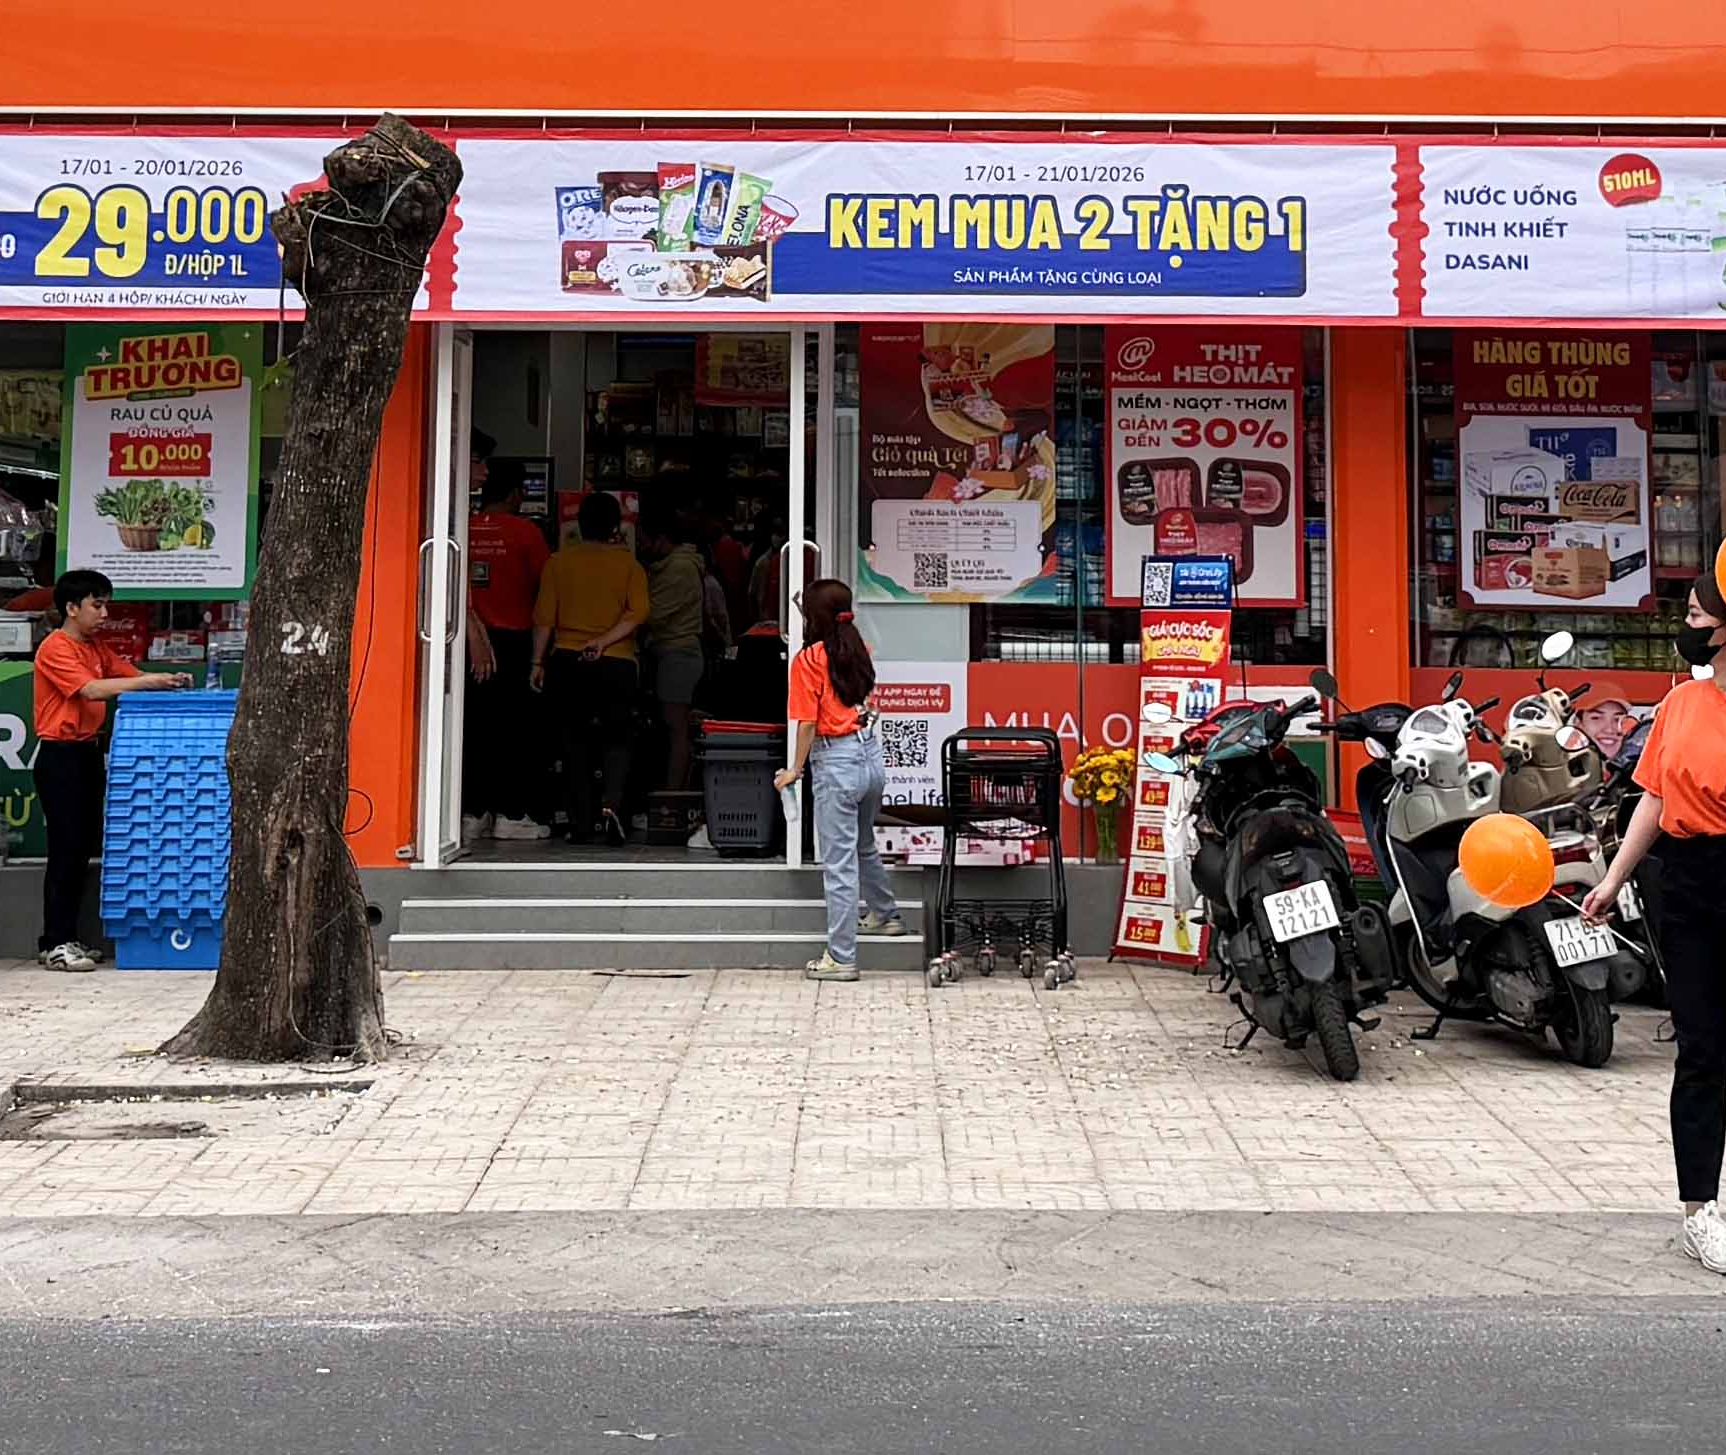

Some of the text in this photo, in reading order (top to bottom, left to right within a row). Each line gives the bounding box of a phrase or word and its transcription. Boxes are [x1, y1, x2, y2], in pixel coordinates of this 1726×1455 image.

[59, 160, 244, 178] 17/01 20/01/2026
[964, 164, 1145, 184] 17/01 21/01/2026
[1602, 168, 1656, 192] 510ML
[1443, 183, 1578, 208] NƯỚC UỐNG
[35, 184, 268, 278] 29.000
[829, 184, 1303, 269] KEM MUA 2 TẶNG 1
[1444, 214, 1569, 240] TINH KHIẾT
[165, 252, 248, 282] Đ/HỘP 1L
[1444, 253, 1530, 272] DASANI
[953, 266, 1163, 290] SẢN PHẨM TẶNG CÙNG LOẠI
[118, 334, 209, 363] KHAI
[1201, 344, 1262, 364] THỊT
[1474, 337, 1631, 366] HÀNG THÙNG
[86, 356, 240, 392] TRƯƠNG
[1173, 362, 1294, 385] HEO MÁT
[1505, 367, 1599, 399] GIÁ TỐT
[110, 403, 214, 423] RAU CỦ QUẢ
[1117, 394, 1287, 411] MỀM NGỌT THƠM
[1118, 414, 1288, 449] GIẢM 30%
[1125, 433, 1161, 447] ĐẾN
[119, 443, 203, 473] 10.000
[280, 621, 330, 657] 24
[1275, 890, 1321, 916] 59-KA
[1278, 908, 1331, 937] 121.21
